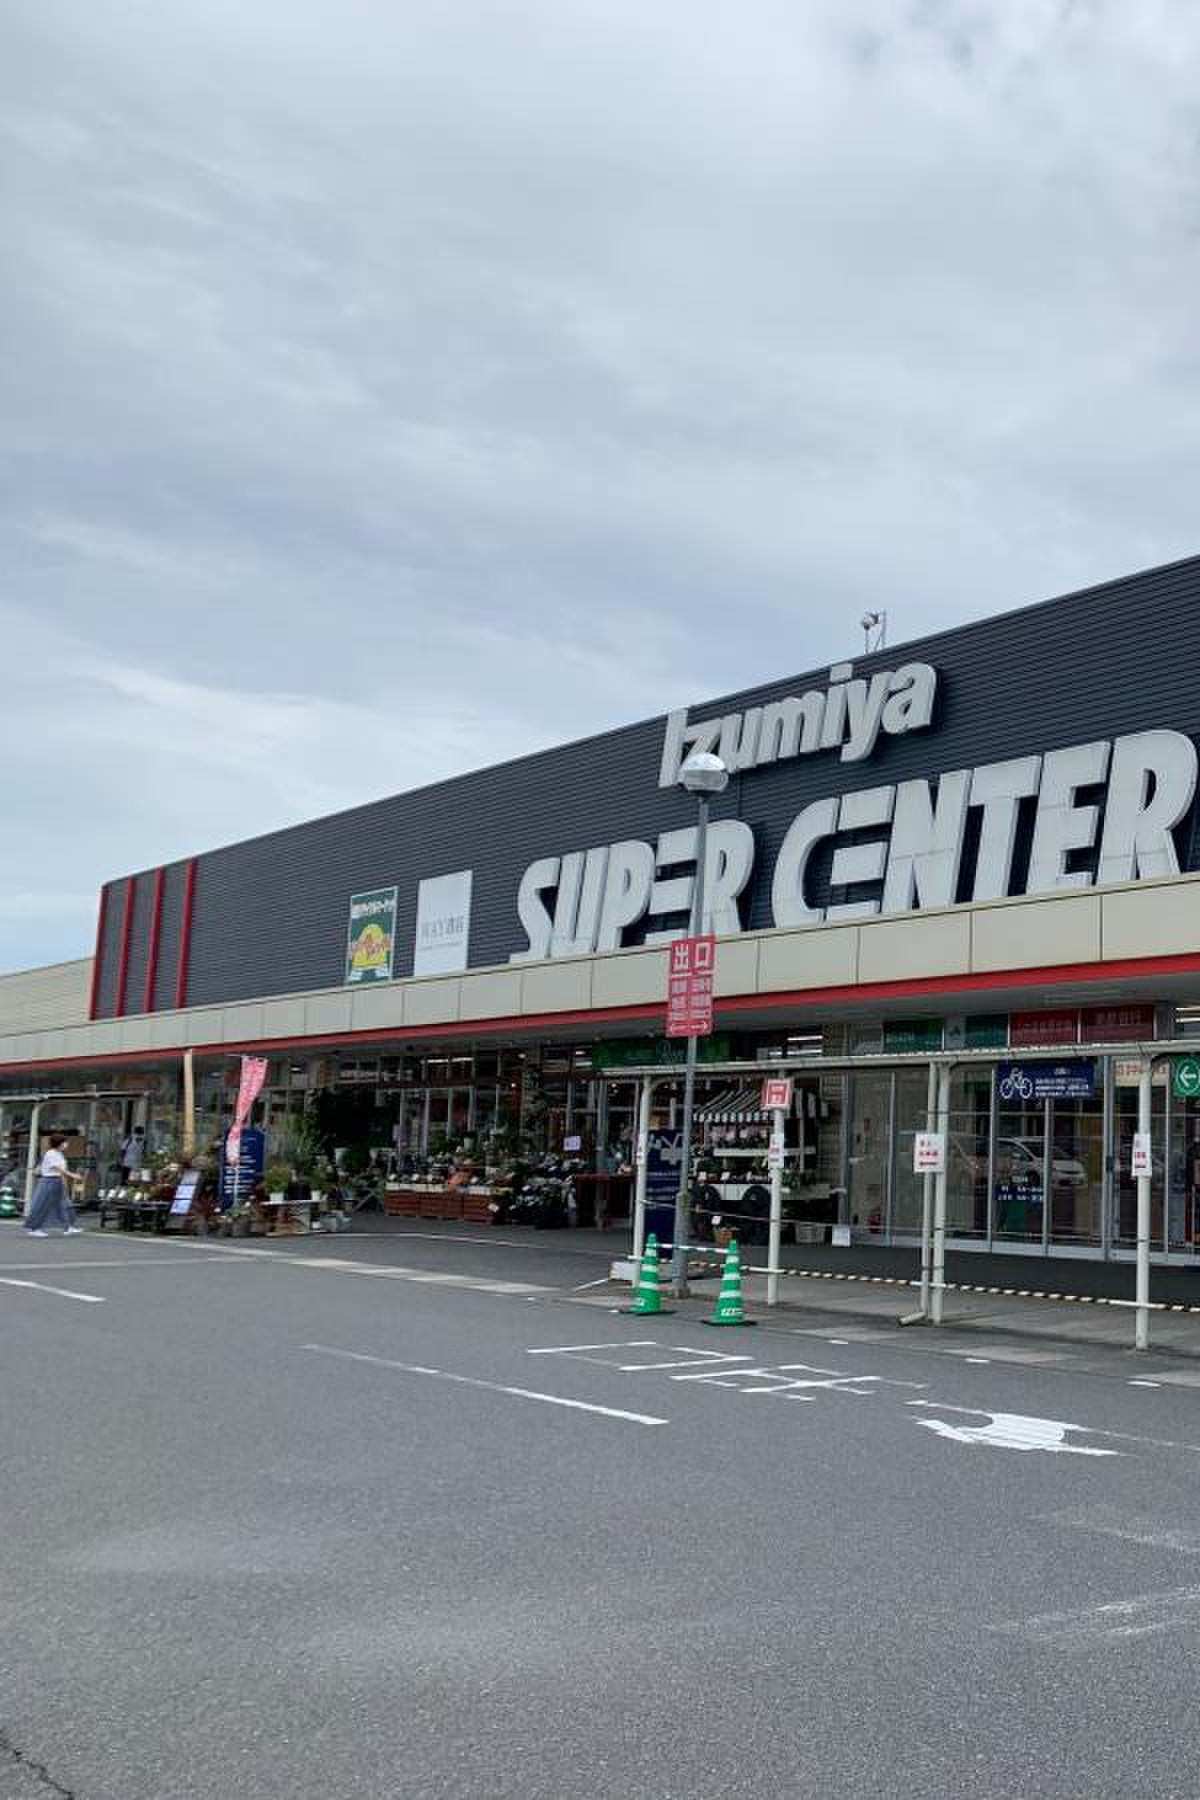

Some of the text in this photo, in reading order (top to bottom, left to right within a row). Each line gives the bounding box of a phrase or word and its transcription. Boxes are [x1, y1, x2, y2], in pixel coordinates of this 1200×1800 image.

[658, 661, 937, 788] Izumiya
[508, 727, 1200, 965] SUPER CENTER
